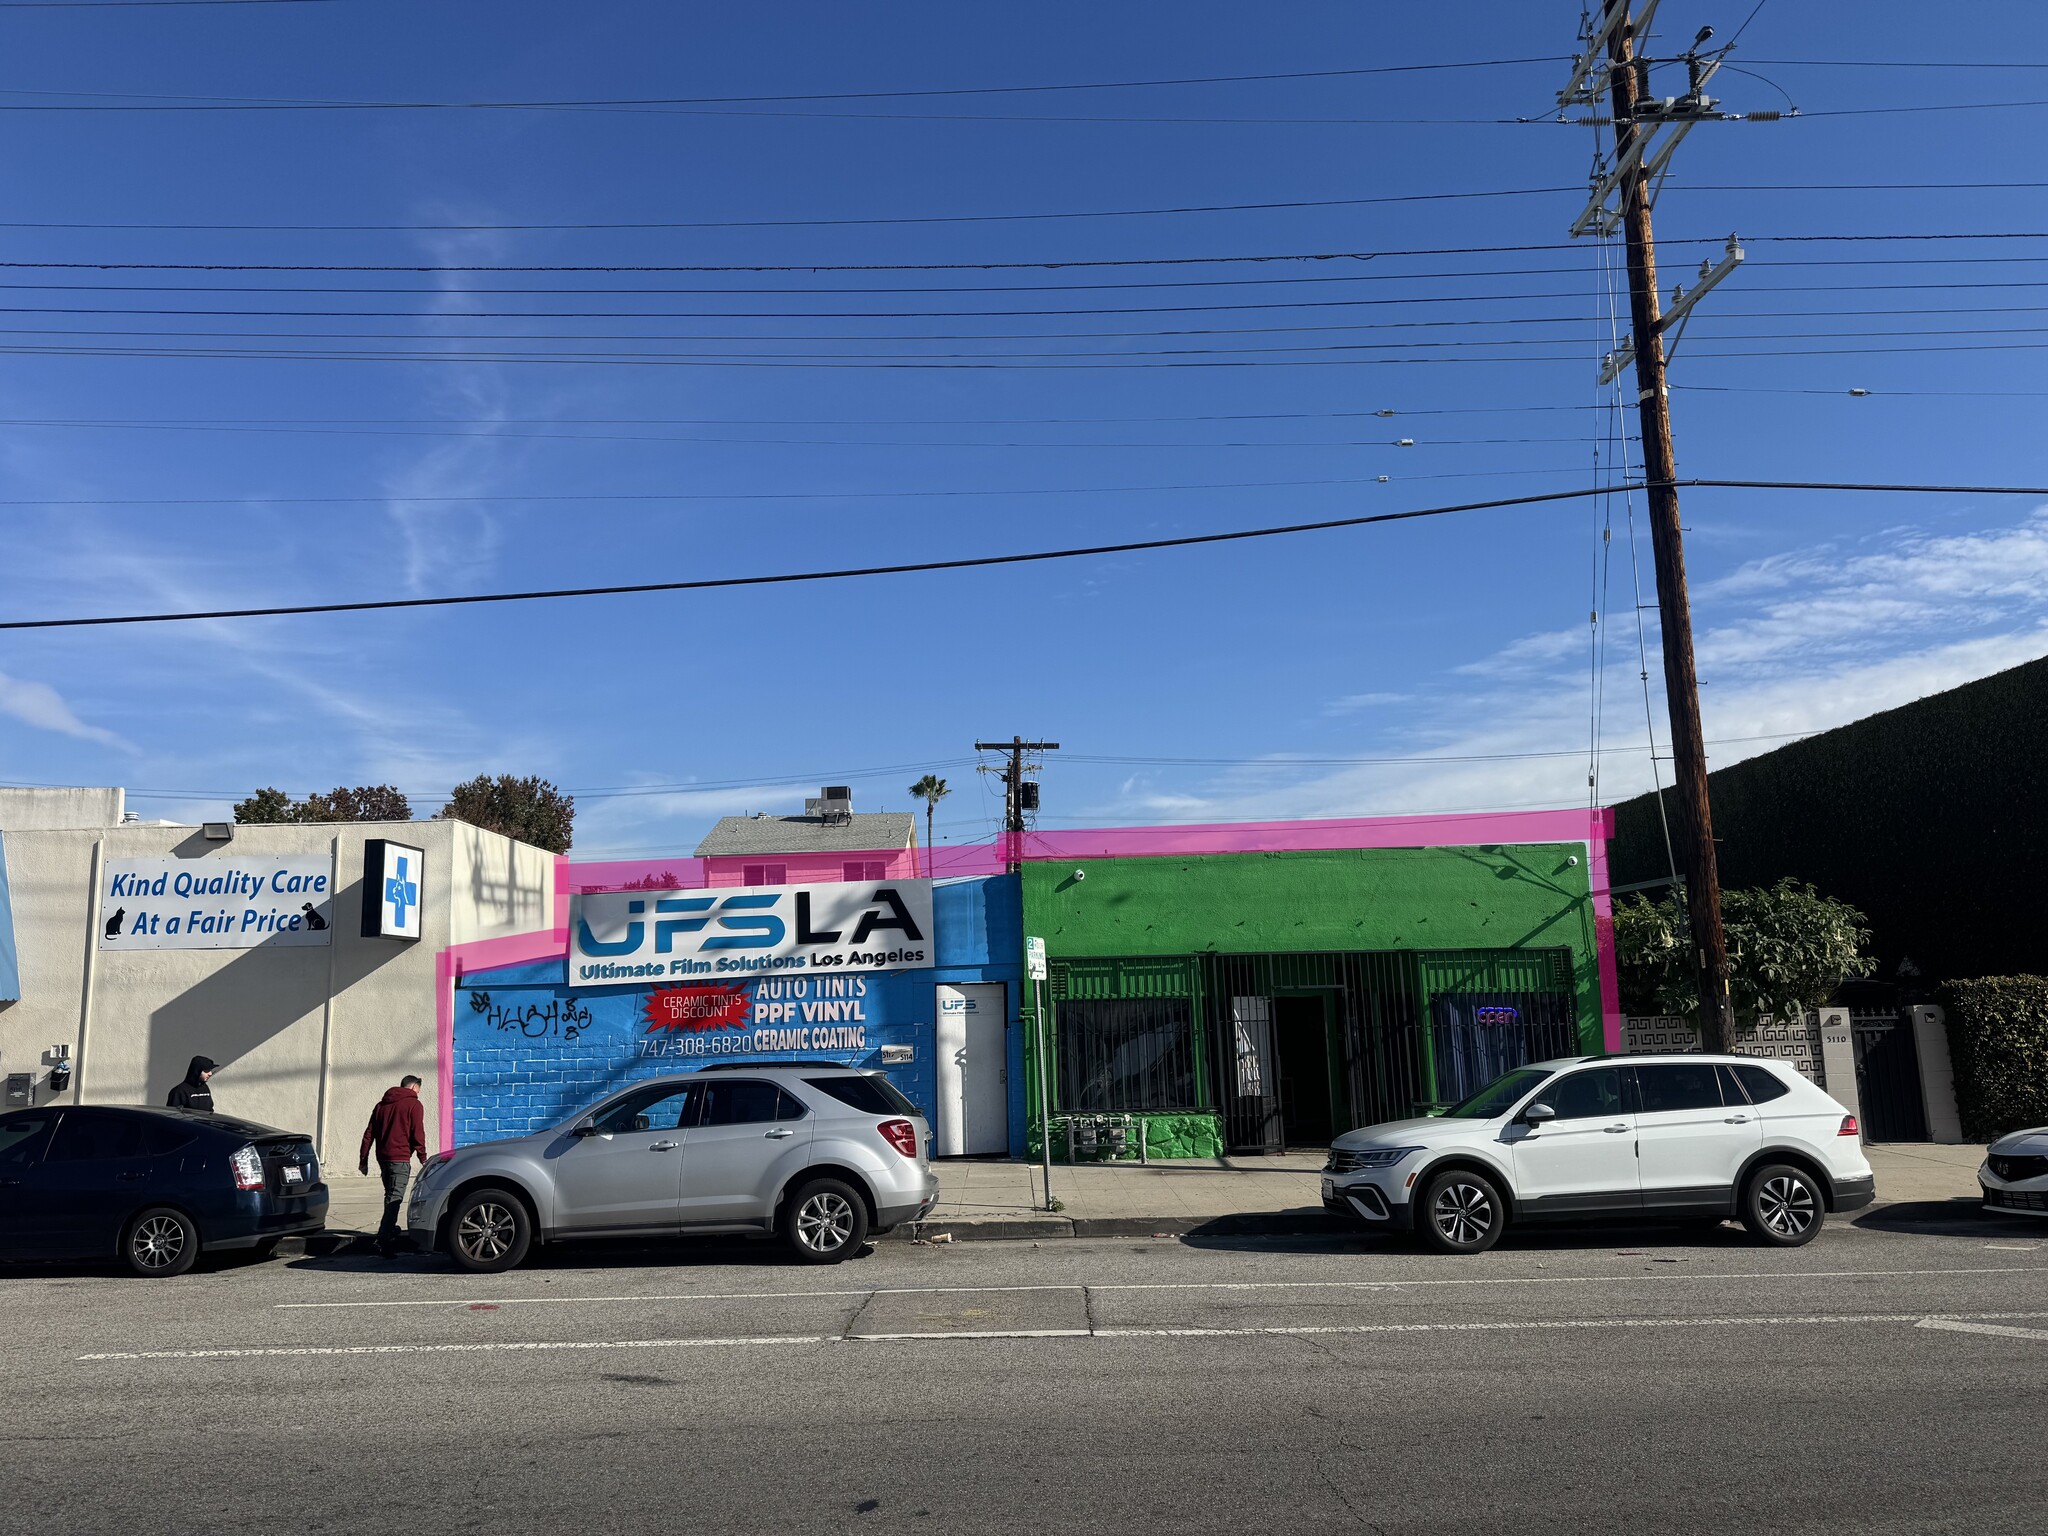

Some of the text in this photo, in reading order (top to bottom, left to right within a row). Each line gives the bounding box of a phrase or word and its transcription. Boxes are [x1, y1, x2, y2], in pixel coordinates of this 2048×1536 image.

[110, 870, 327, 900] Kind Quality Care
[131, 908, 302, 935] At a Fair Price
[579, 948, 925, 980] Ultimate Film Solutions Los Angeles
[756, 975, 867, 1000] AUTO TINTS
[663, 993, 742, 1008] CERAMIC TINTS
[671, 1006, 730, 1019] DISCOUNT
[755, 1000, 866, 1024] PPF VINYL
[942, 999, 977, 1010] UFS
[638, 1035, 751, 1058] 747-308-6820
[754, 1026, 866, 1051] CERAMIC COATING
